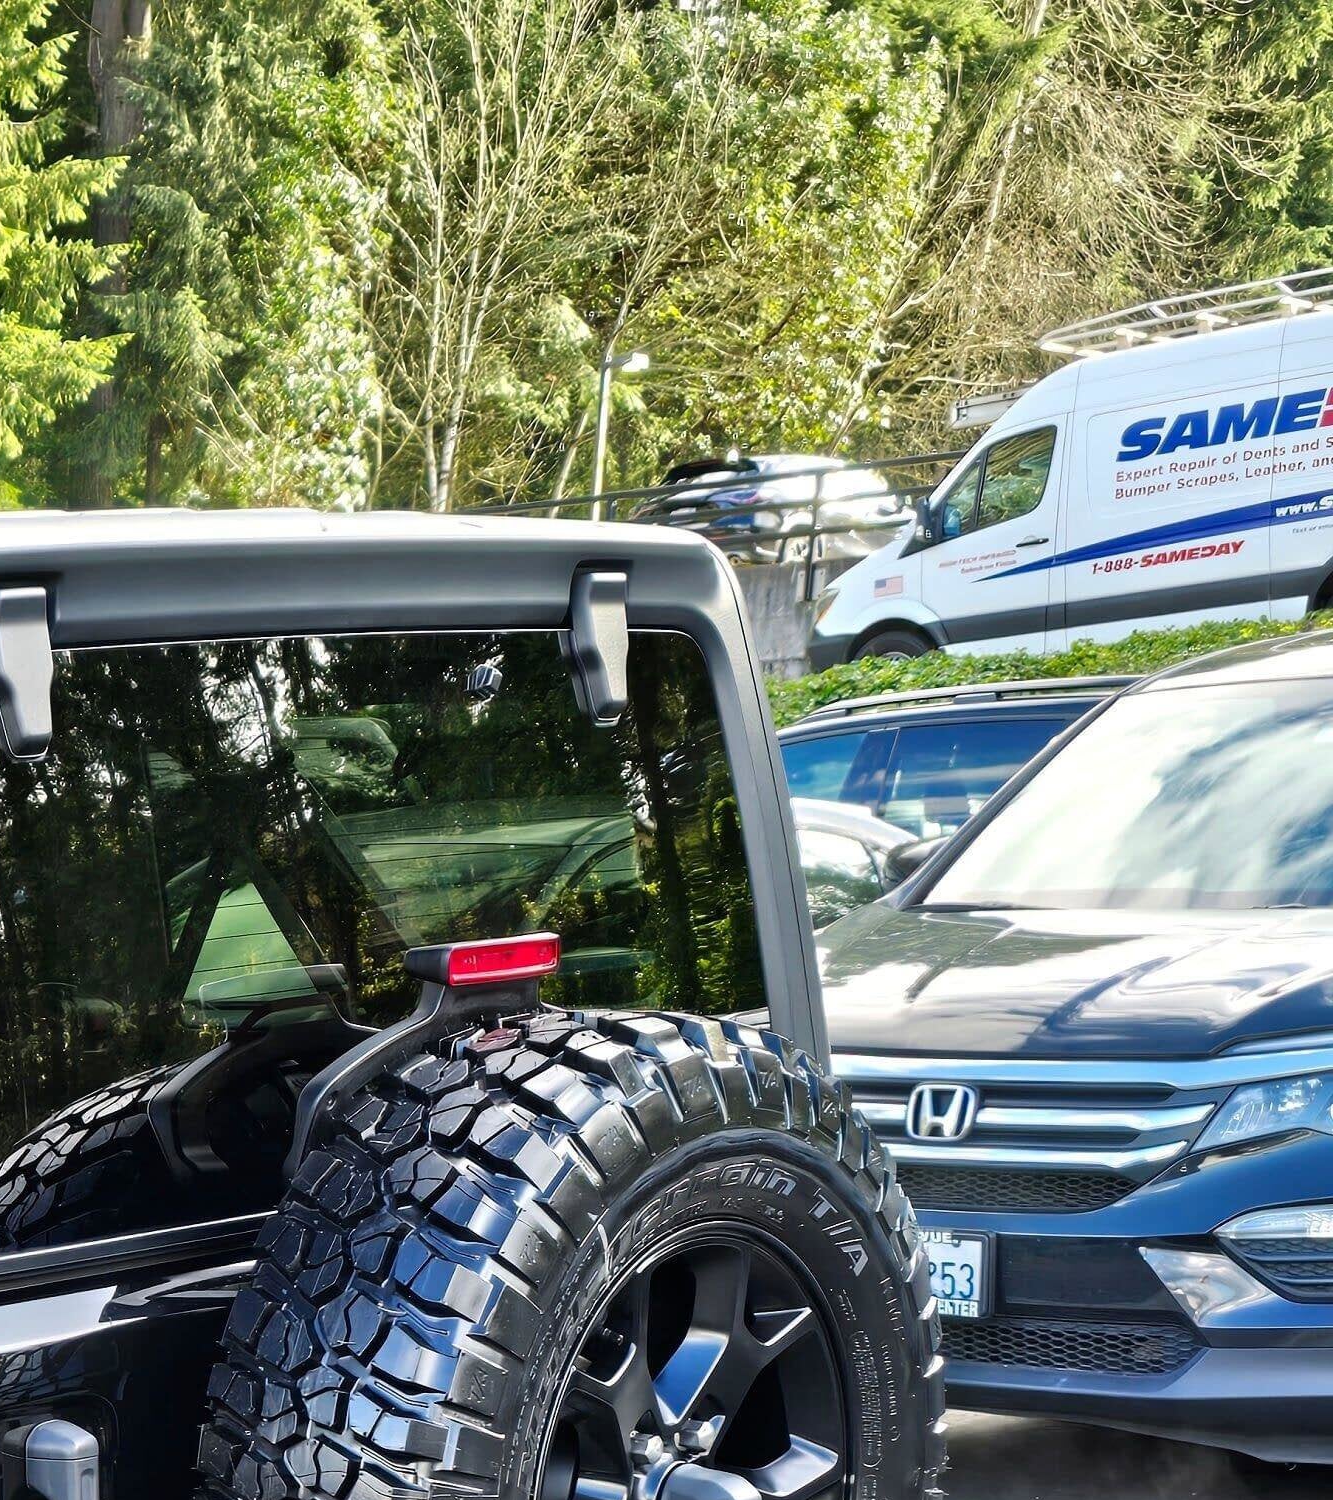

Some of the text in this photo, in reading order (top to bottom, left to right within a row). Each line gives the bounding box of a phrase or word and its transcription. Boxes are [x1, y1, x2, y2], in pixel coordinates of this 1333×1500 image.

[1116, 466, 1164, 483] Expert
[1169, 455, 1218, 475] Repair
[1222, 451, 1238, 465] of
[1243, 444, 1286, 462] Dents
[1291, 438, 1320, 454] and
[1115, 481, 1172, 500] Bumper
[1177, 472, 1239, 490] Scrapes,
[1245, 459, 1307, 479] Leather,
[1275, 495, 1333, 517] www.S
[1092, 540, 1245, 575] 1-888-SAMEDAY
[937, 1299, 979, 1318] ENTER
